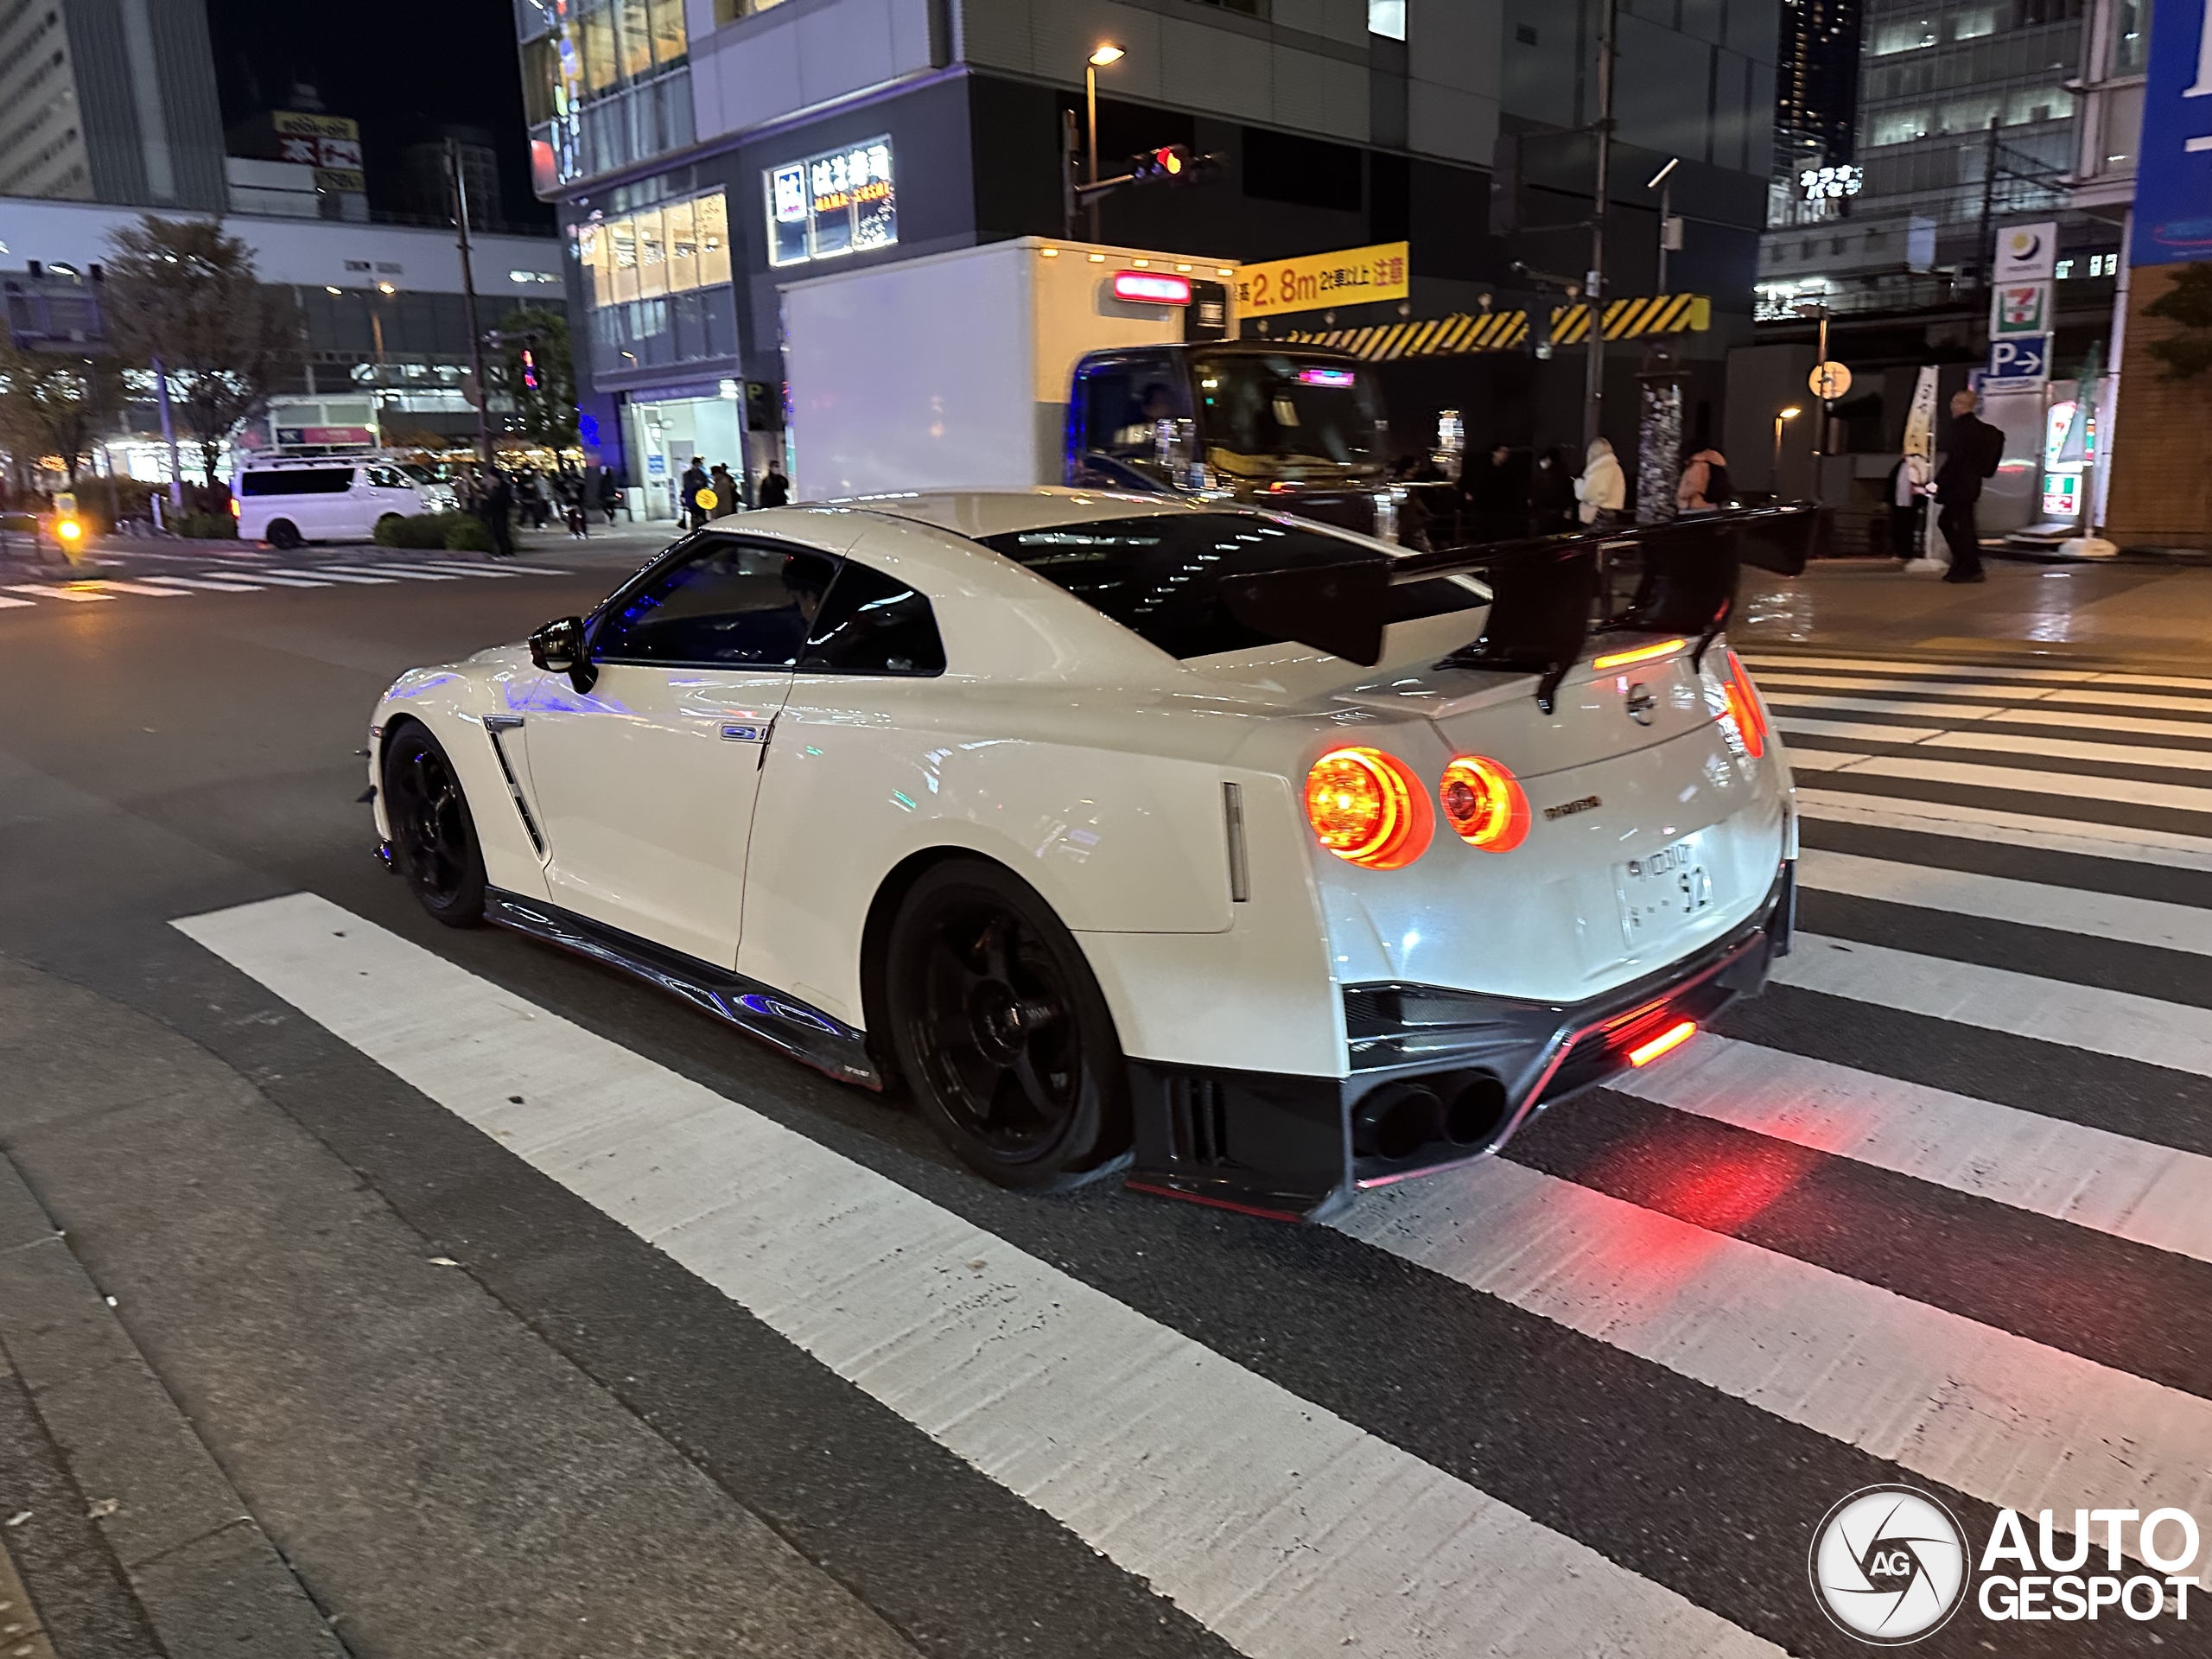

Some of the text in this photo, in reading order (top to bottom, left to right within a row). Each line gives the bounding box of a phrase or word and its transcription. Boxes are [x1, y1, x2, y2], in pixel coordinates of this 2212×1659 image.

[280, 138, 316, 164] 本
[1254, 269, 1317, 306] 2.8m
[1990, 342, 2018, 376] P
